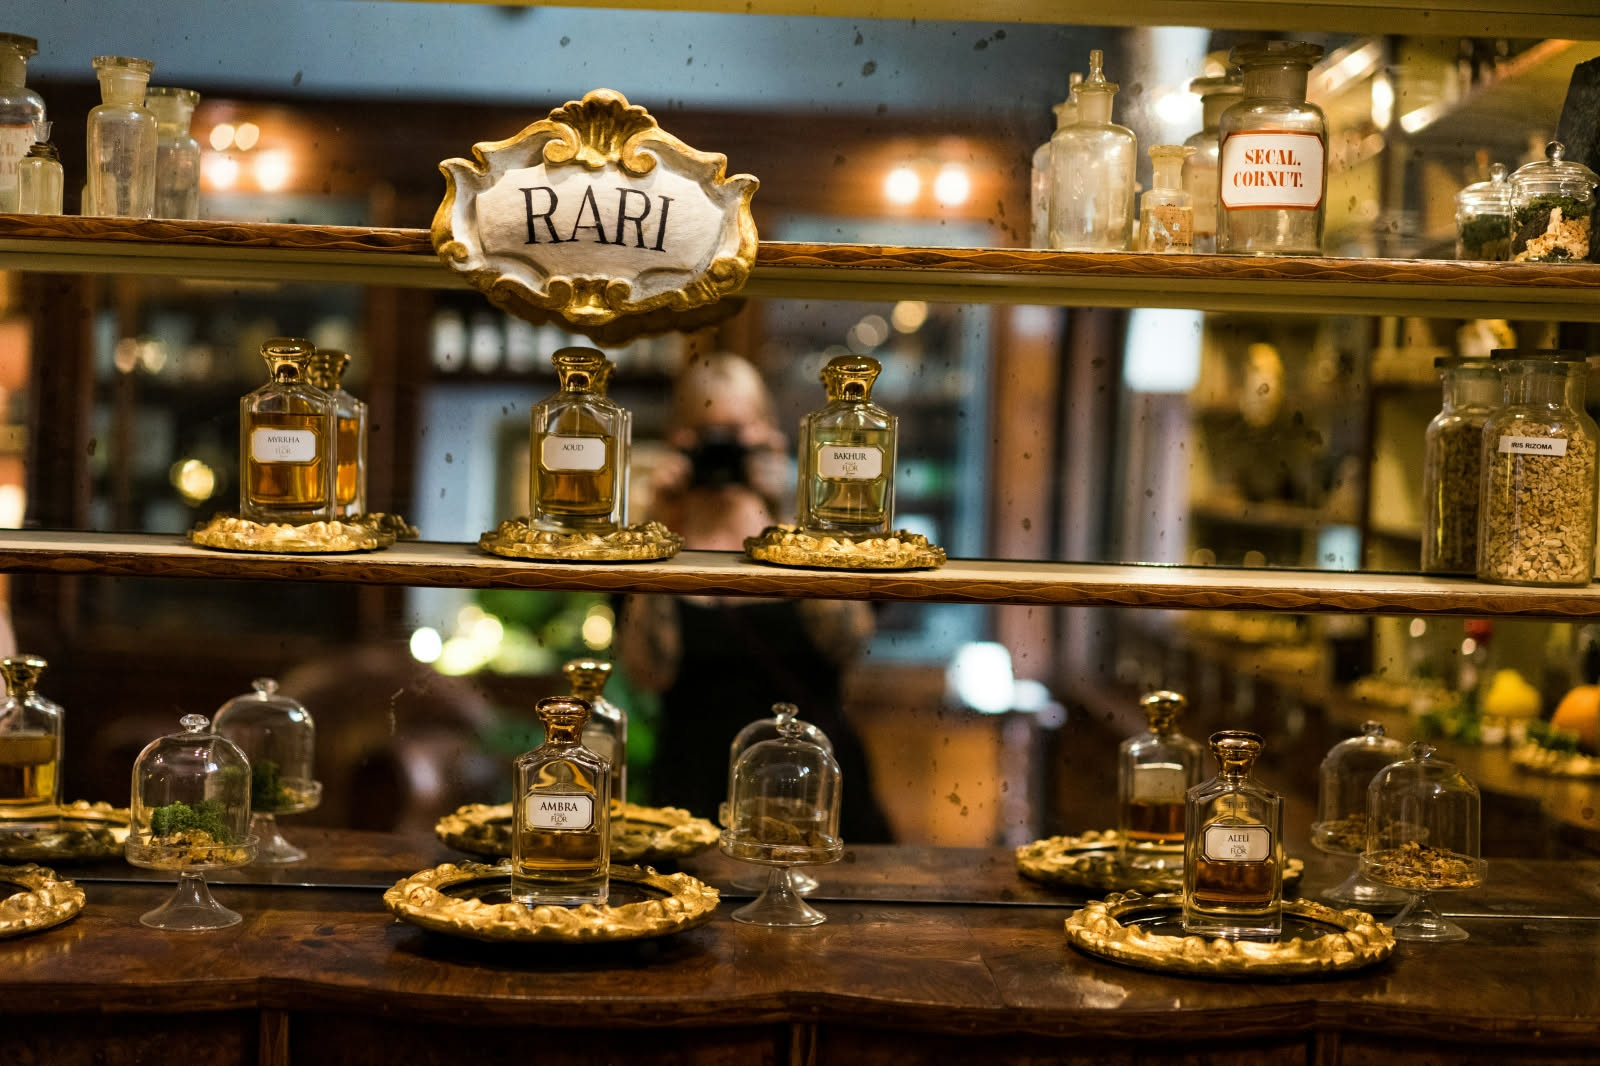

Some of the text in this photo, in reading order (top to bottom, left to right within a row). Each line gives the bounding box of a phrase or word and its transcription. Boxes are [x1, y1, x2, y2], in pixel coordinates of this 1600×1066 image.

[1245, 149, 1301, 166] SECAL.
[1233, 171, 1303, 188] CORNUT.
[518, 185, 675, 252] RARI
[833, 452, 867, 461] BAKHUR
[540, 801, 578, 812] AMBRA
[550, 815, 568, 823] FLOR
[1230, 847, 1248, 855] FLOR
